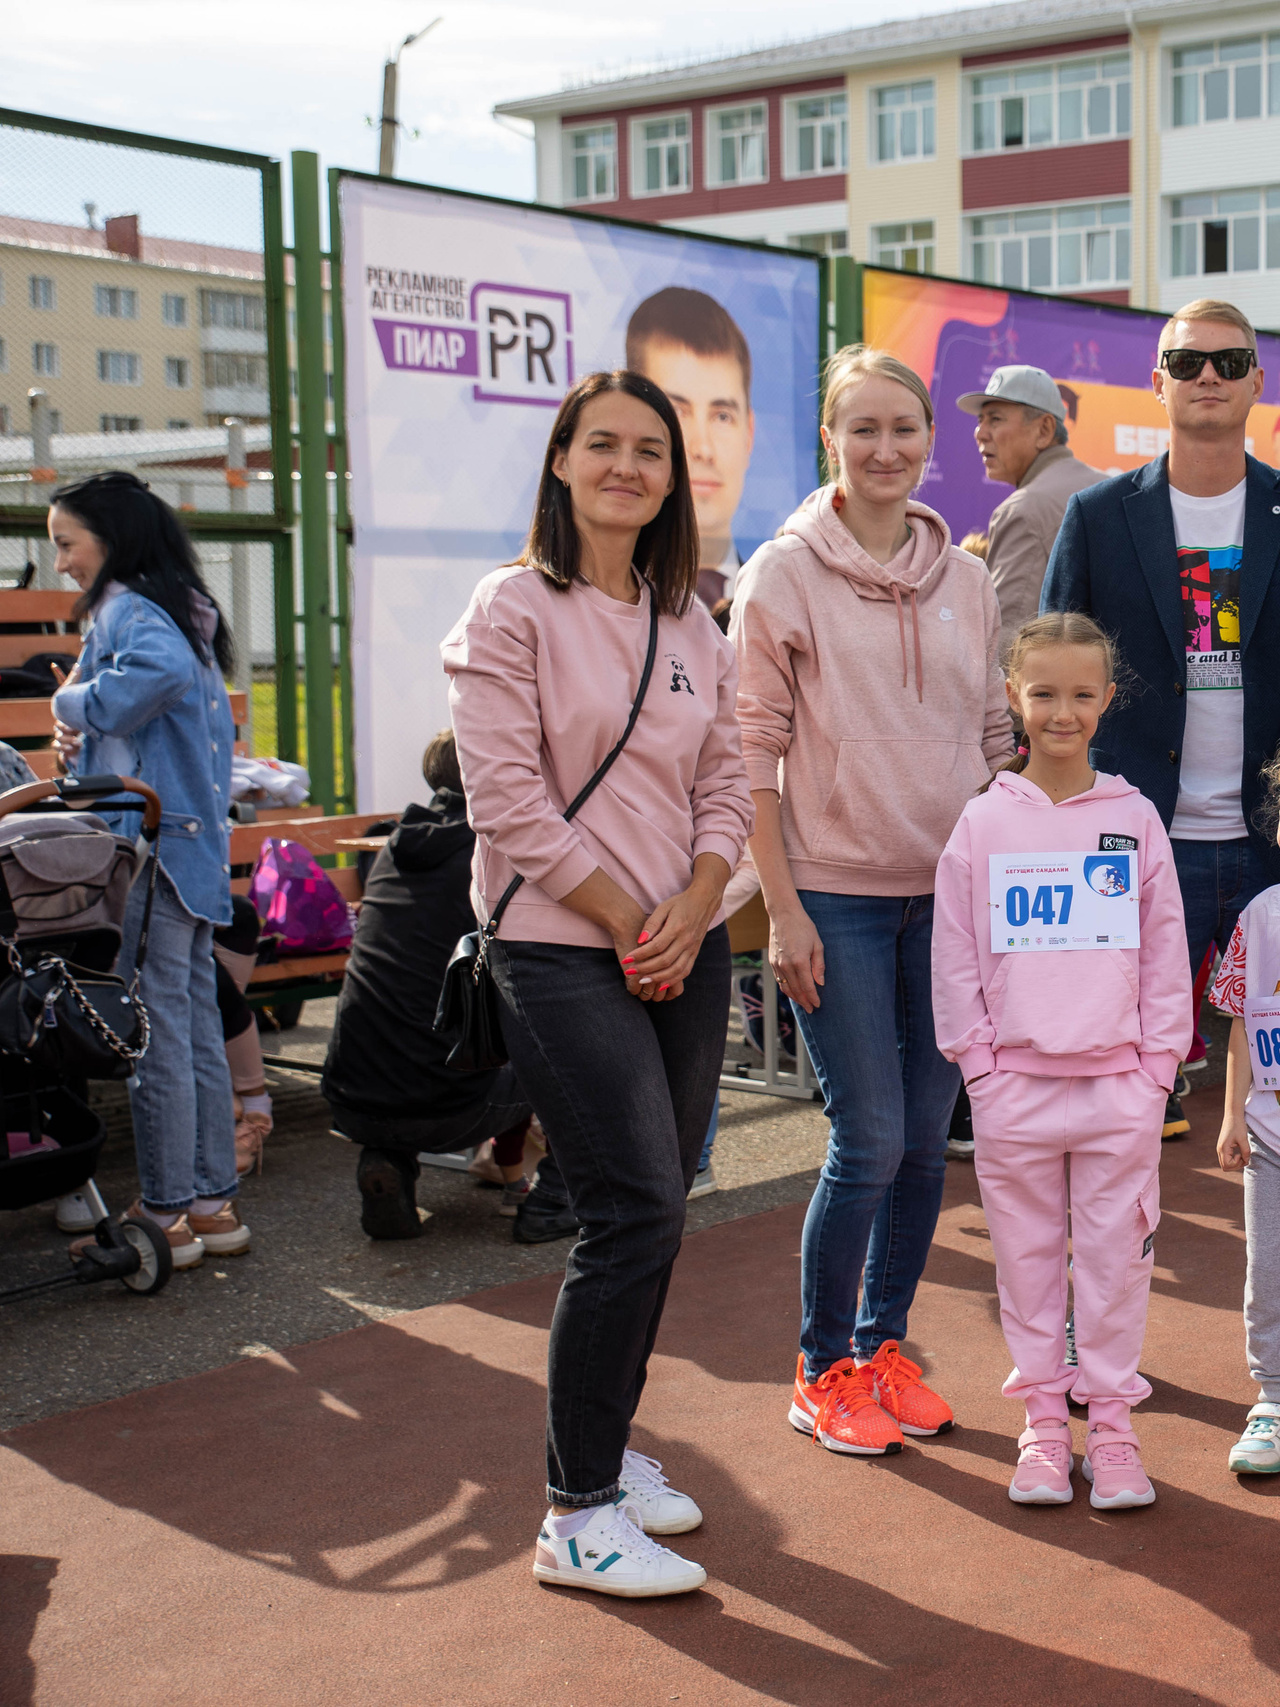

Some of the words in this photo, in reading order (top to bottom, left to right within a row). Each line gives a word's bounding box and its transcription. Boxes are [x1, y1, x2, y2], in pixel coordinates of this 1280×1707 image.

[367, 266, 467, 298] РЕКЛАМНОЕ
[372, 290, 465, 320] АГЕНТСТВО
[393, 326, 466, 370] ПИАР
[488, 307, 557, 385] PR
[1199, 651, 1228, 663] and
[1006, 885, 1073, 927] 047
